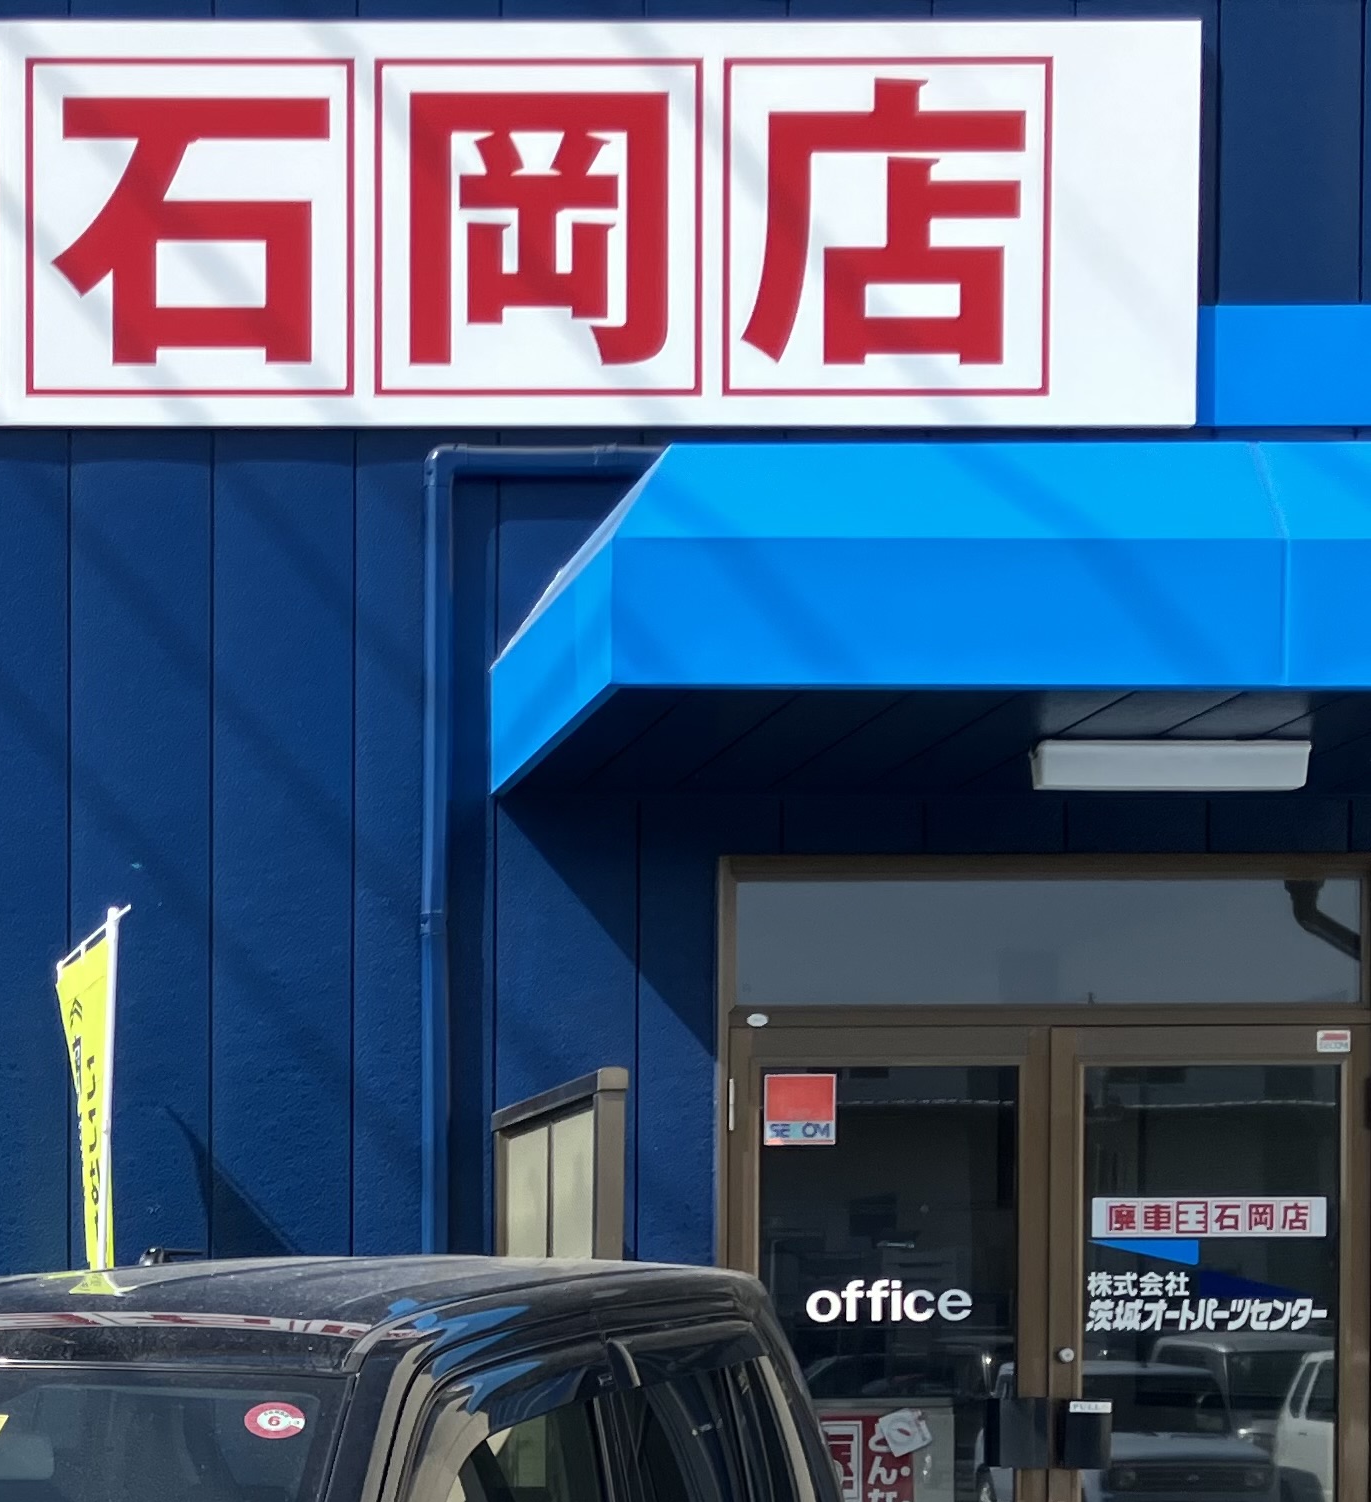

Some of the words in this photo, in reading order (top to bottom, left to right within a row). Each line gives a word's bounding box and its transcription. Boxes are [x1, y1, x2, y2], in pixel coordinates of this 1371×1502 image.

[769, 1123, 830, 1138] SEOM
[1087, 1271, 1190, 1297] 株式会社
[806, 1279, 973, 1322] office
[1085, 1298, 1328, 1332] 茨城オートパーツセンター
